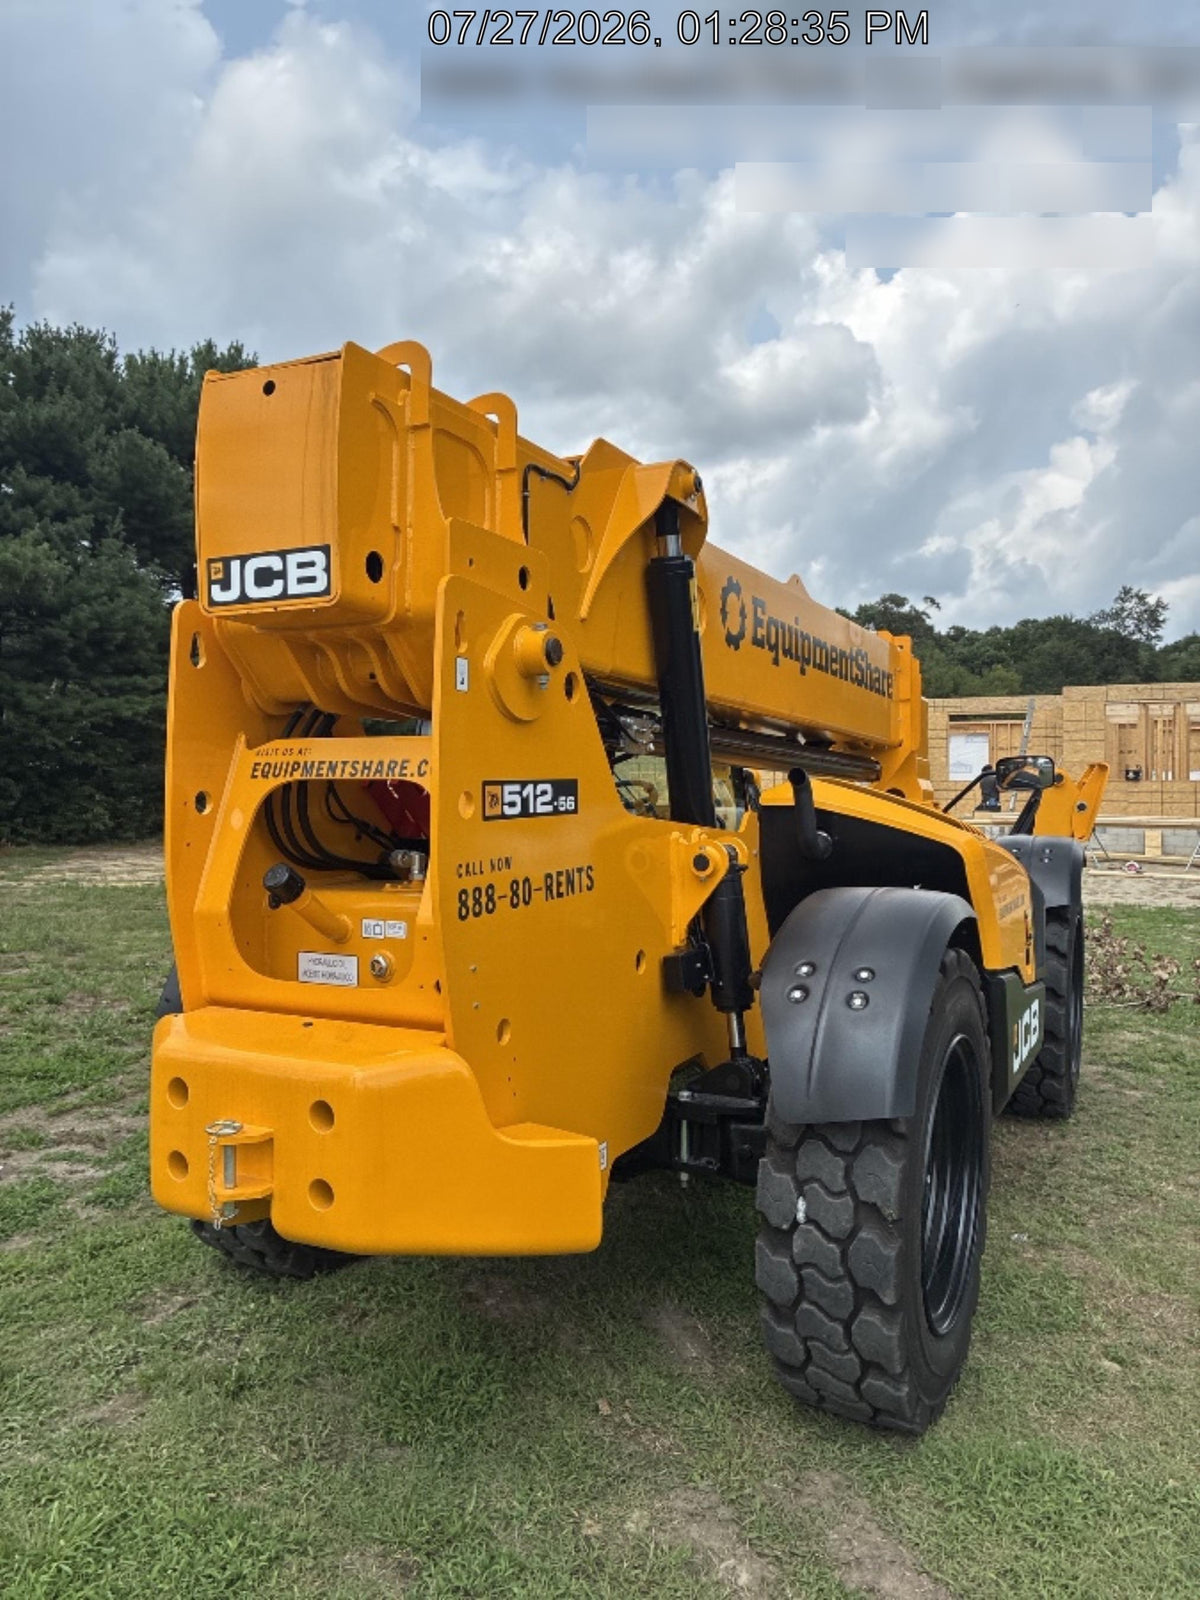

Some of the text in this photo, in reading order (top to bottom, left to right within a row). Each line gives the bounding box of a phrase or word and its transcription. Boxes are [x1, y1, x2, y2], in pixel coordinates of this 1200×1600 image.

[210, 551, 328, 602] JCB
[752, 595, 893, 699] EquipmentShare
[251, 759, 432, 779] EQUIPMENTSHARE.C
[456, 856, 512, 878] CALL NOW
[458, 865, 594, 921] 888-80-RENTS
[1013, 999, 1039, 1073] JCB
